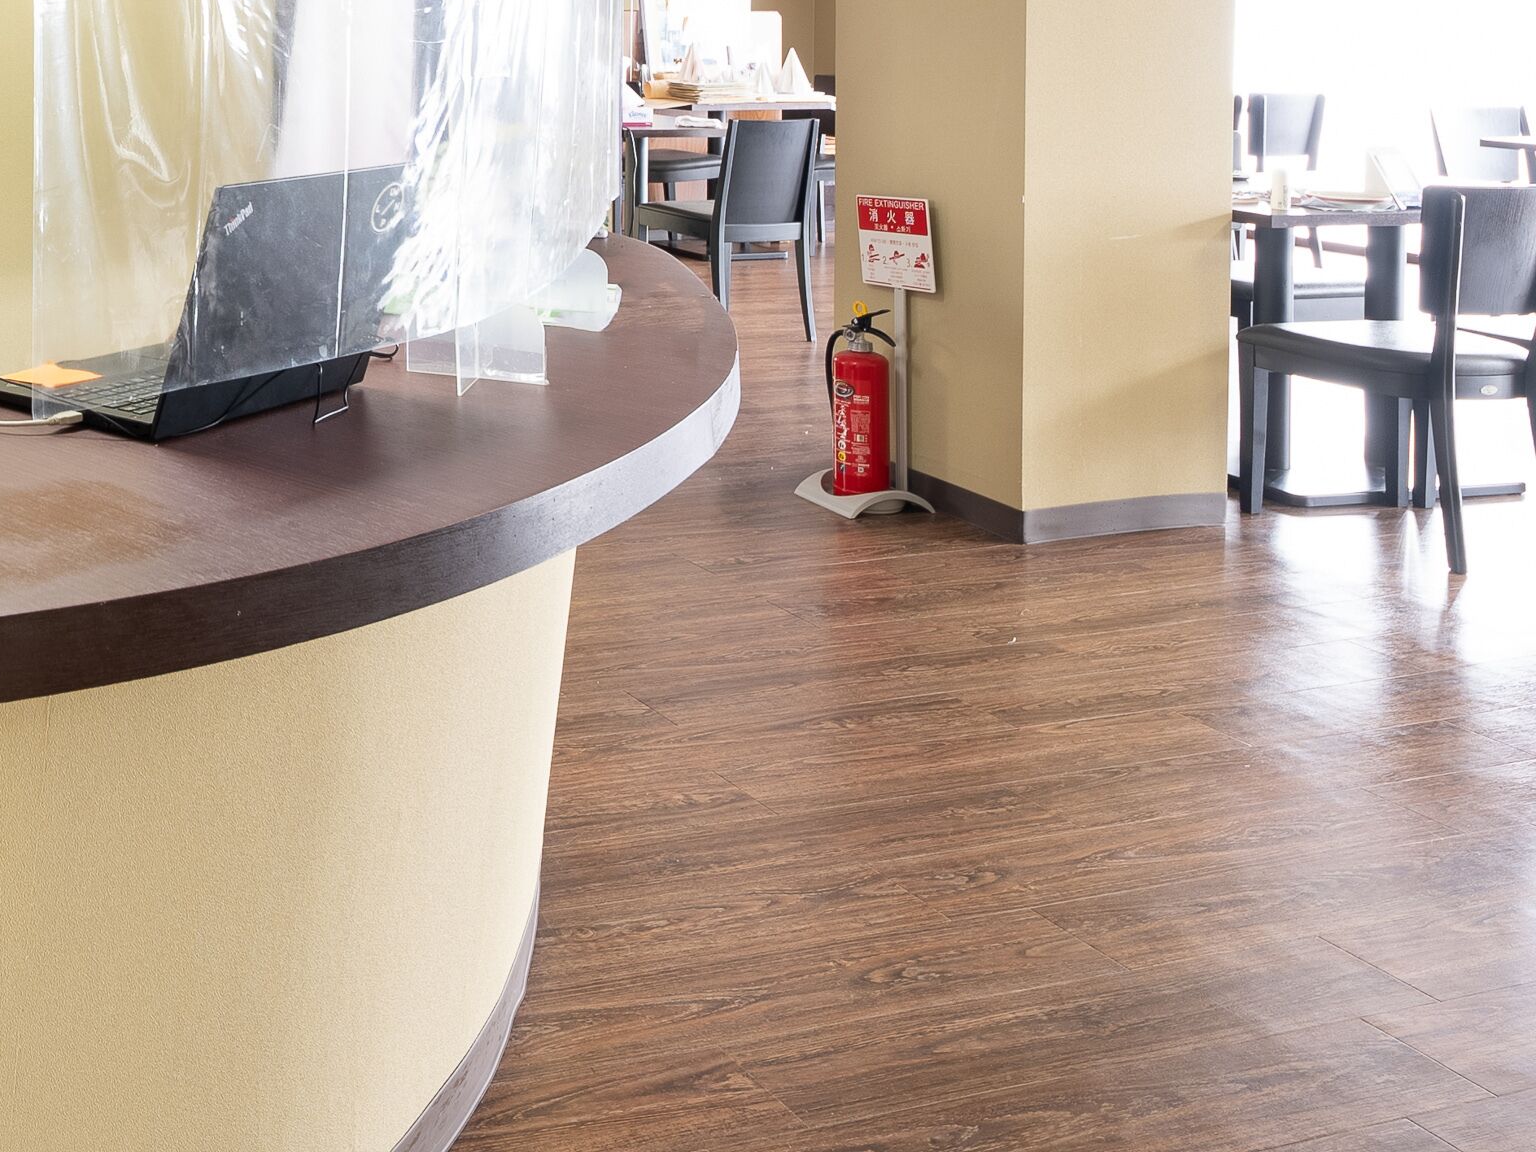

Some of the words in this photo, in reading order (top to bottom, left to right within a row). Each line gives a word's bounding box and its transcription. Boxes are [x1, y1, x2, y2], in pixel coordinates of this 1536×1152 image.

[858, 198, 873, 207] FIRE
[874, 199, 925, 211] EXTINGUISHER
[224, 201, 253, 236] ThinkPad
[868, 208, 915, 225] 消火器
